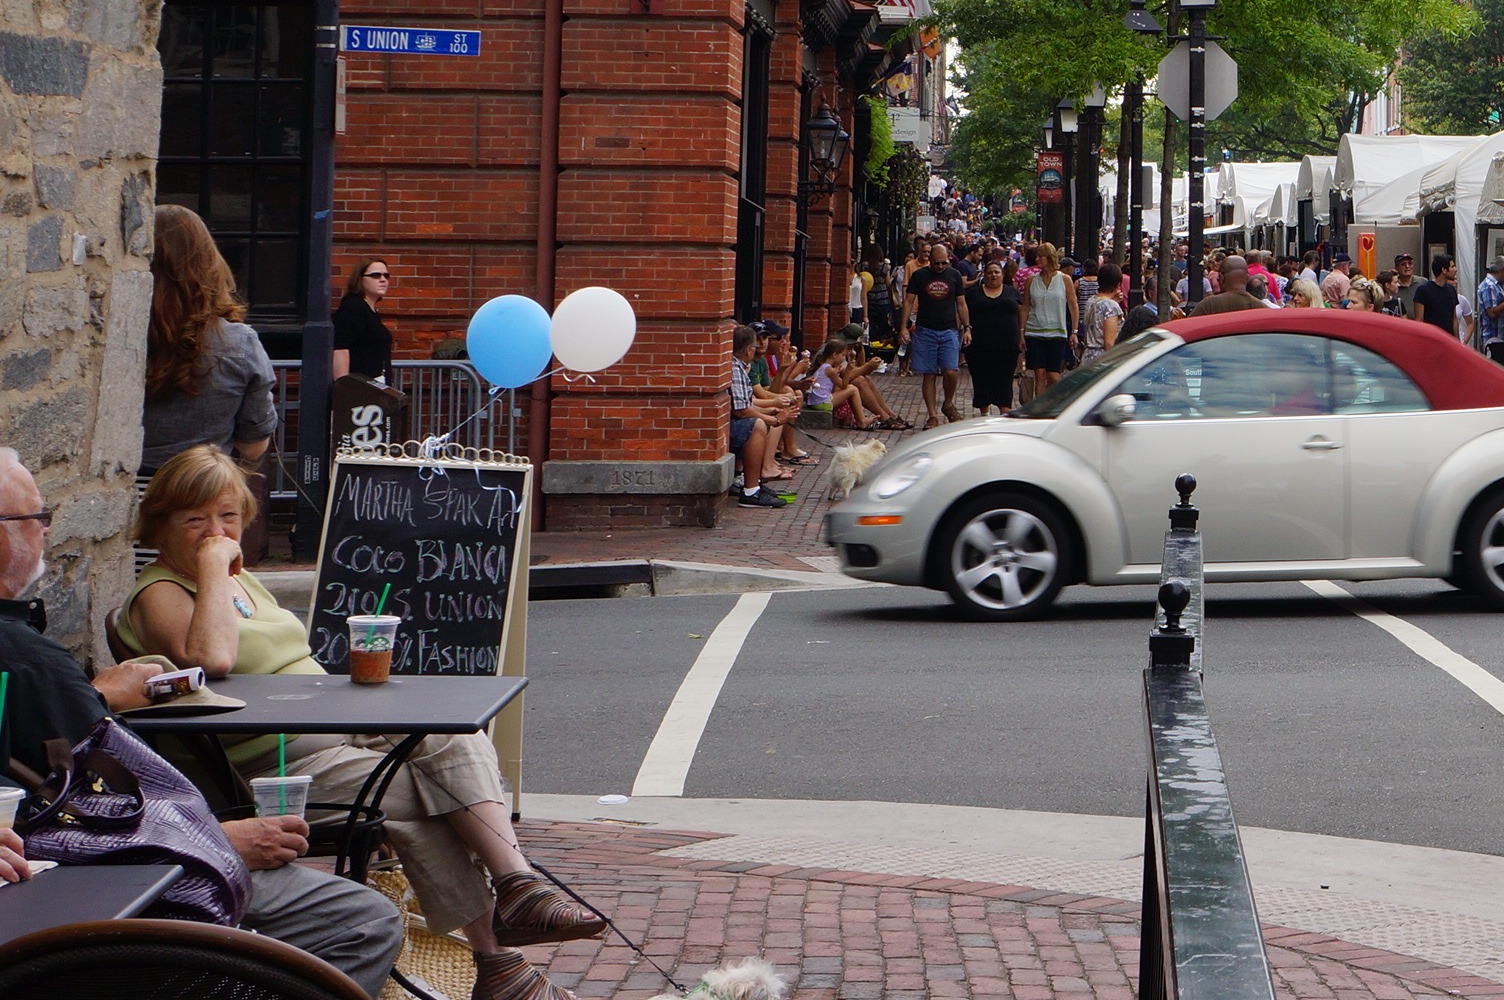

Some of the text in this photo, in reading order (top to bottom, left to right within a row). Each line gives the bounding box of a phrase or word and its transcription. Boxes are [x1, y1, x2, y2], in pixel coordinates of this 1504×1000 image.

[351, 29, 409, 50] S UNION
[449, 43, 468, 53] 100
[453, 33, 468, 43] ST
[334, 473, 416, 527] MARTHA
[323, 582, 379, 617] 210
[424, 590, 503, 623] UNION
[417, 628, 500, 674] FASHION
